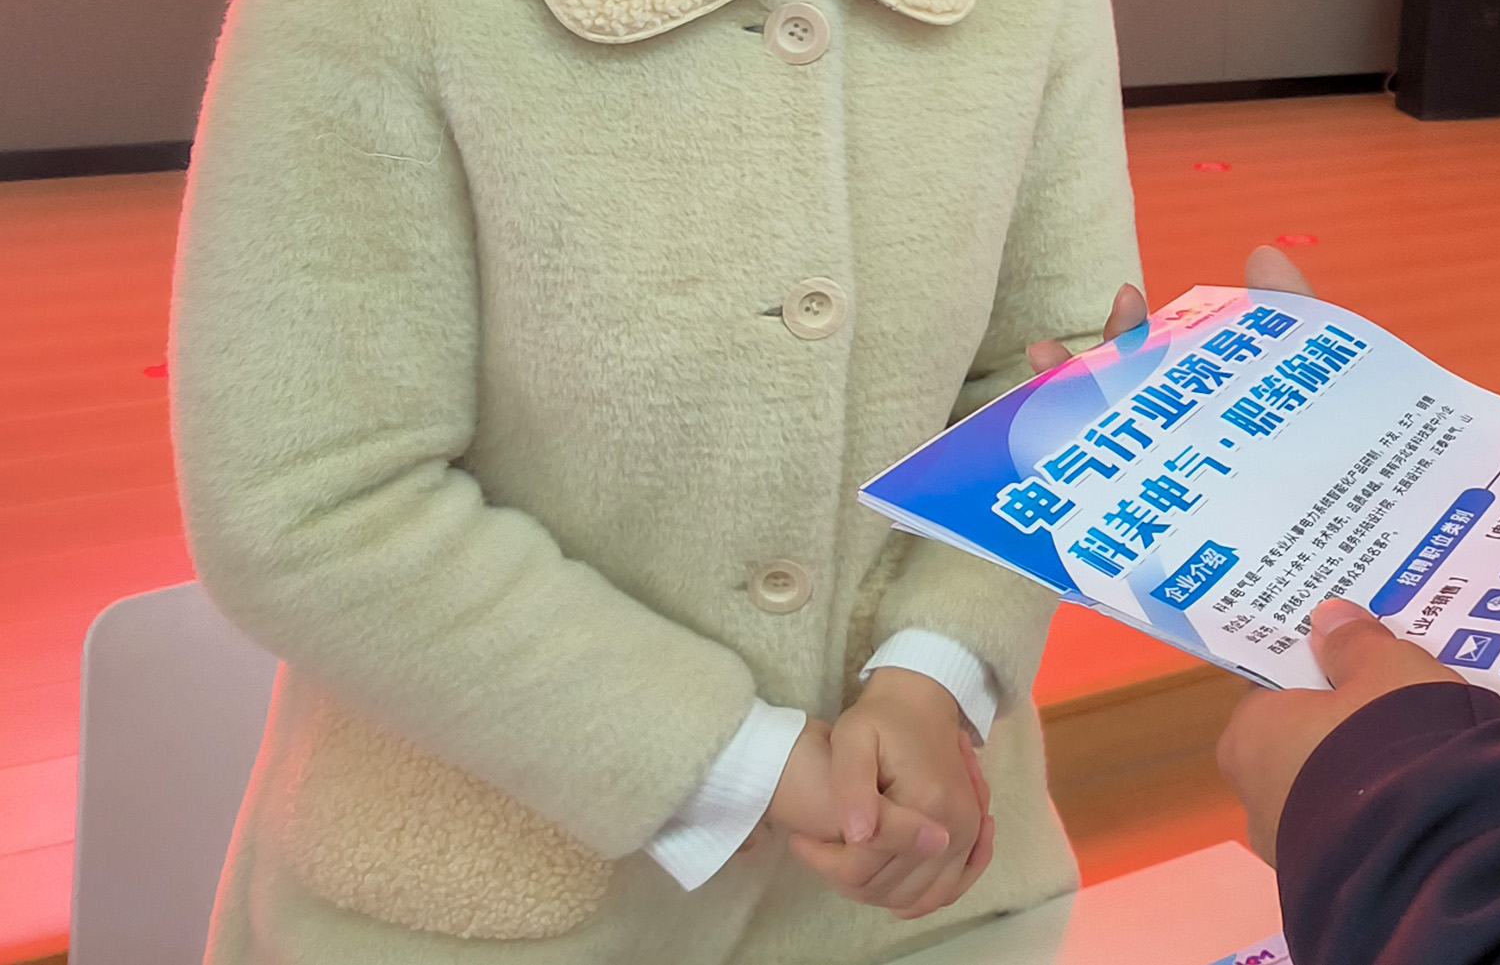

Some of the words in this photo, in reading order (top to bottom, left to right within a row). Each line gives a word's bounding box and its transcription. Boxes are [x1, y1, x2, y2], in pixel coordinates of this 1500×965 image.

[1000, 305, 1299, 529] 电气行业领导者
[1164, 547, 1227, 602] 企业介绍
[1396, 509, 1475, 587] 招聘职位类别
